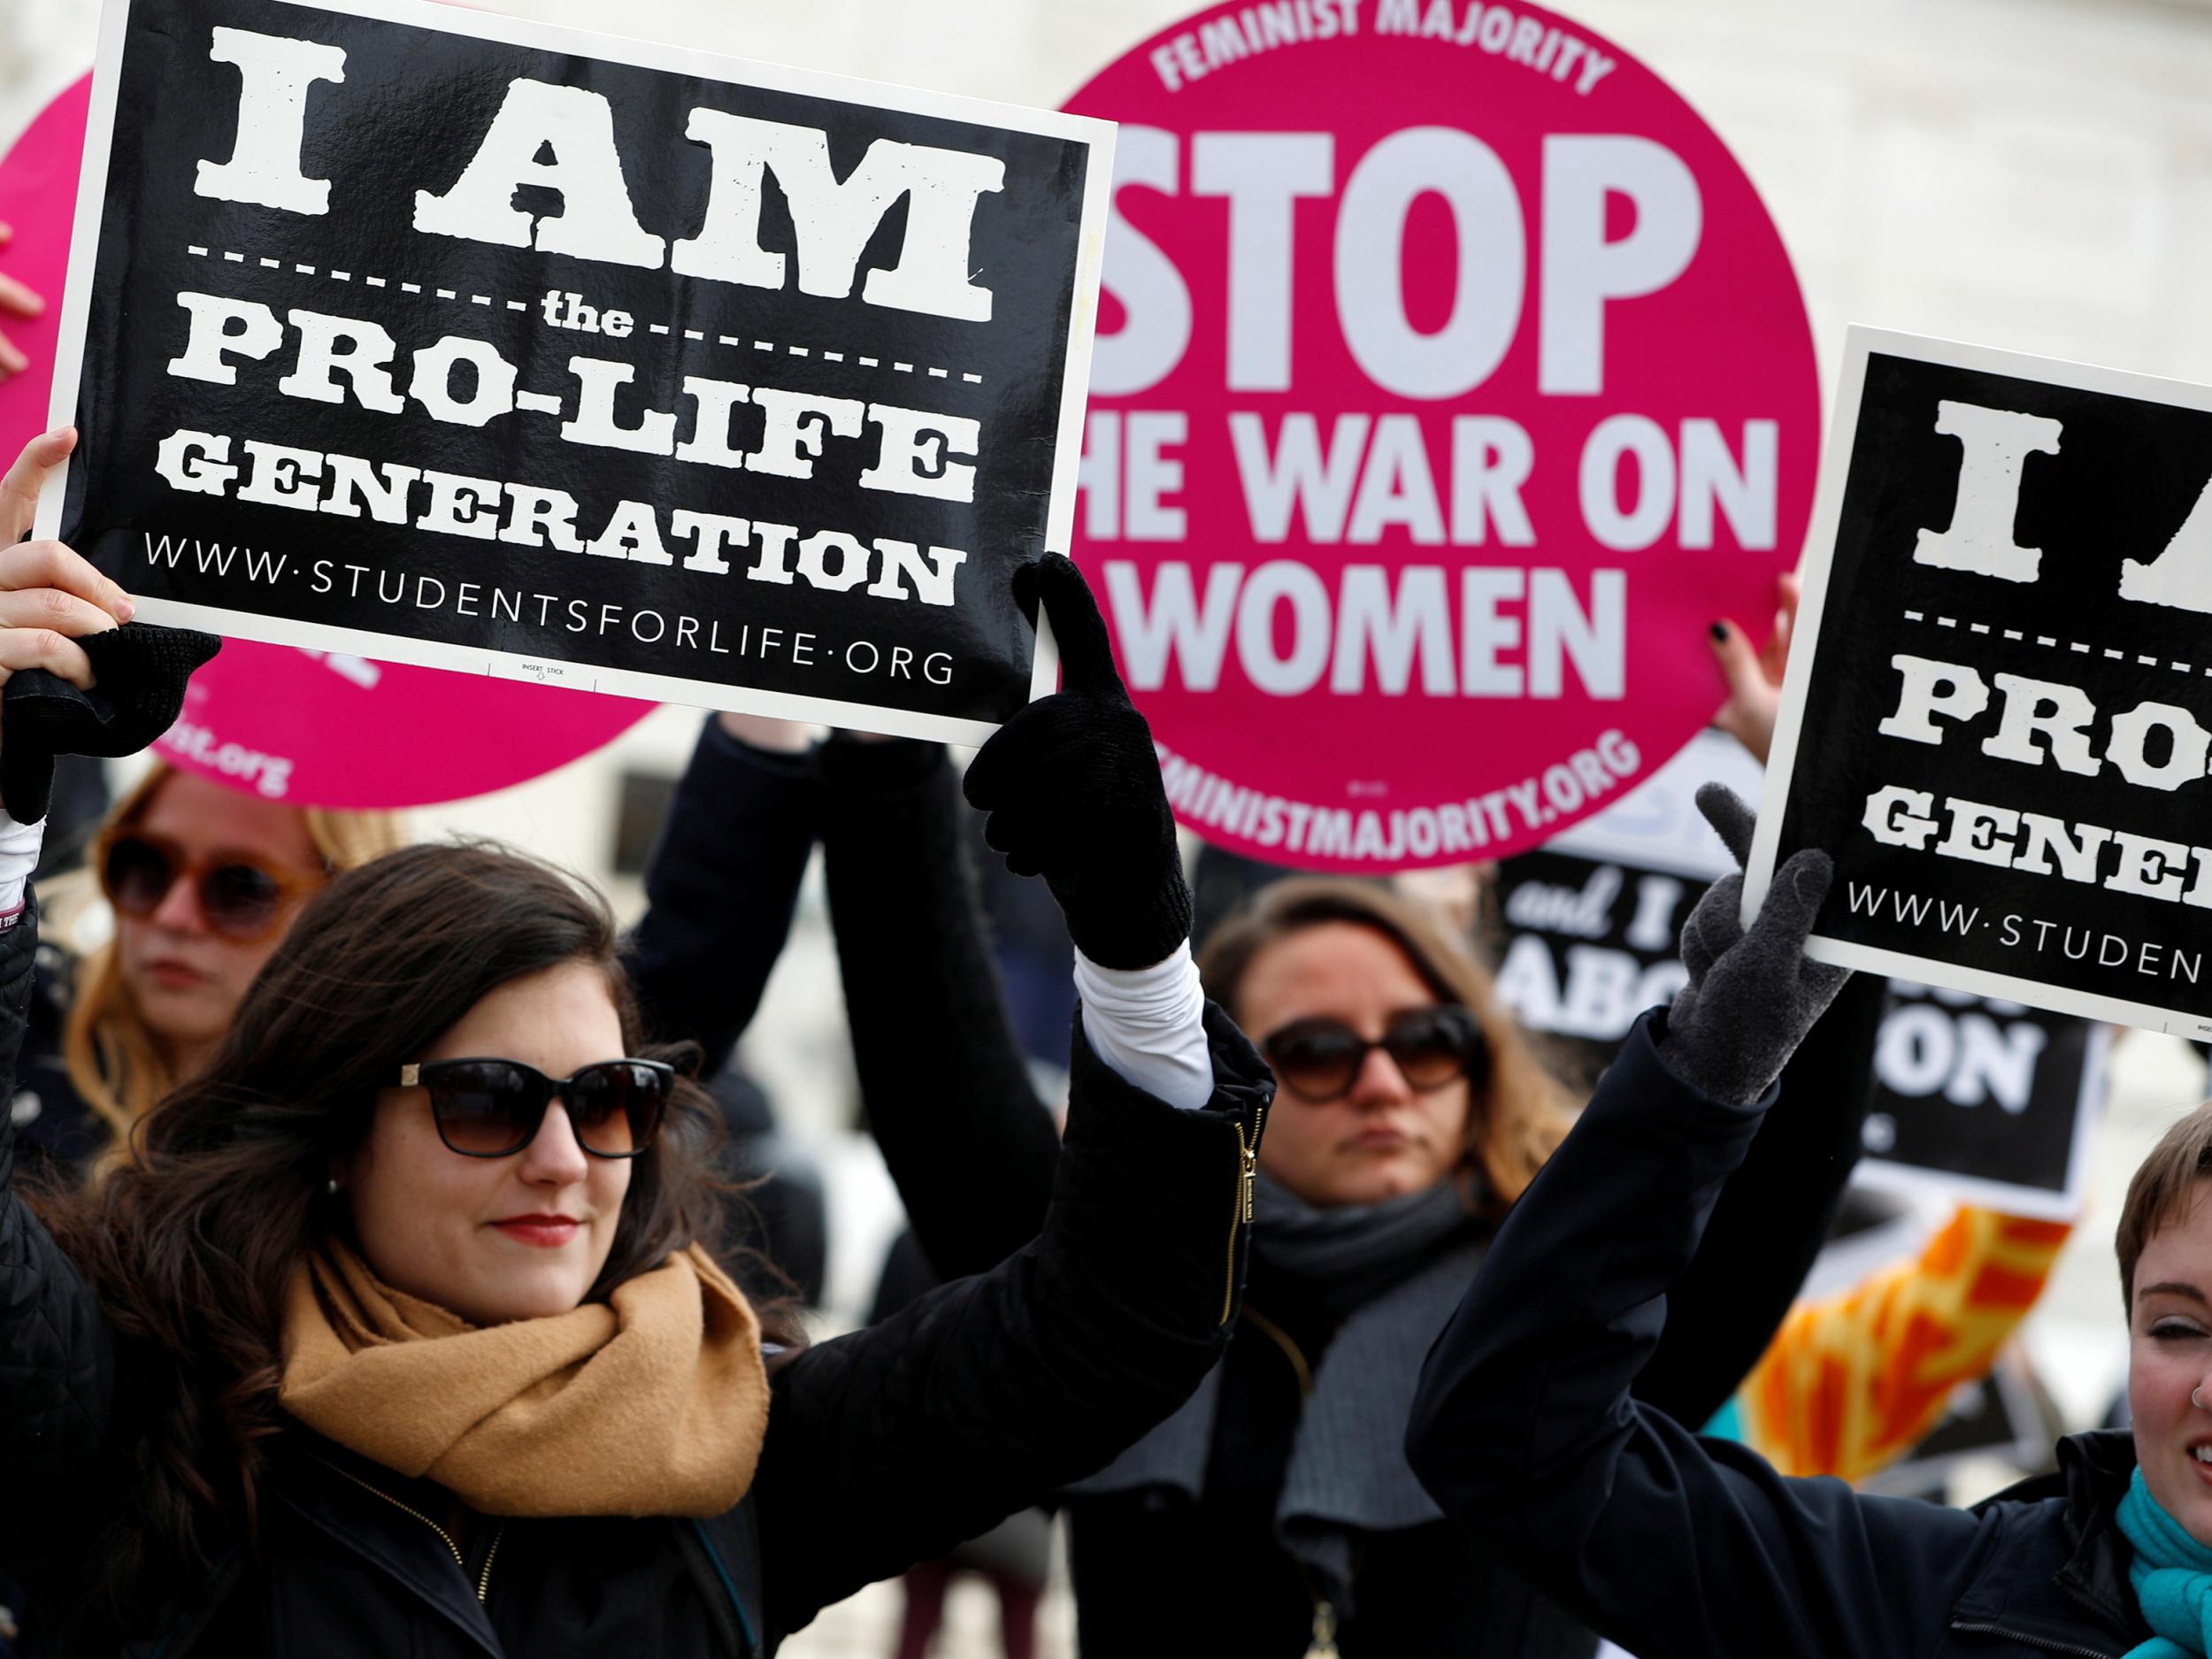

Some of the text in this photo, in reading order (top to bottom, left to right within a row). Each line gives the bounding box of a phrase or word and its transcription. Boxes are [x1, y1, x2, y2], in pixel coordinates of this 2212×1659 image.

[1150, 0, 1616, 96] FEMINIST MAJORITY
[194, 26, 1005, 322] I AM
[541, 289, 634, 338] the
[1087, 124, 1703, 401] STOP
[167, 290, 981, 503] PRO-LIFE
[154, 428, 967, 606] GENERATION
[1077, 410, 1779, 551] HE WAR ON
[1913, 399, 2063, 584] I
[522, 663, 544, 672] INSERT
[1102, 559, 1627, 701] WOMEN
[1878, 653, 2212, 792] PRO
[1506, 864, 1685, 952] and I
